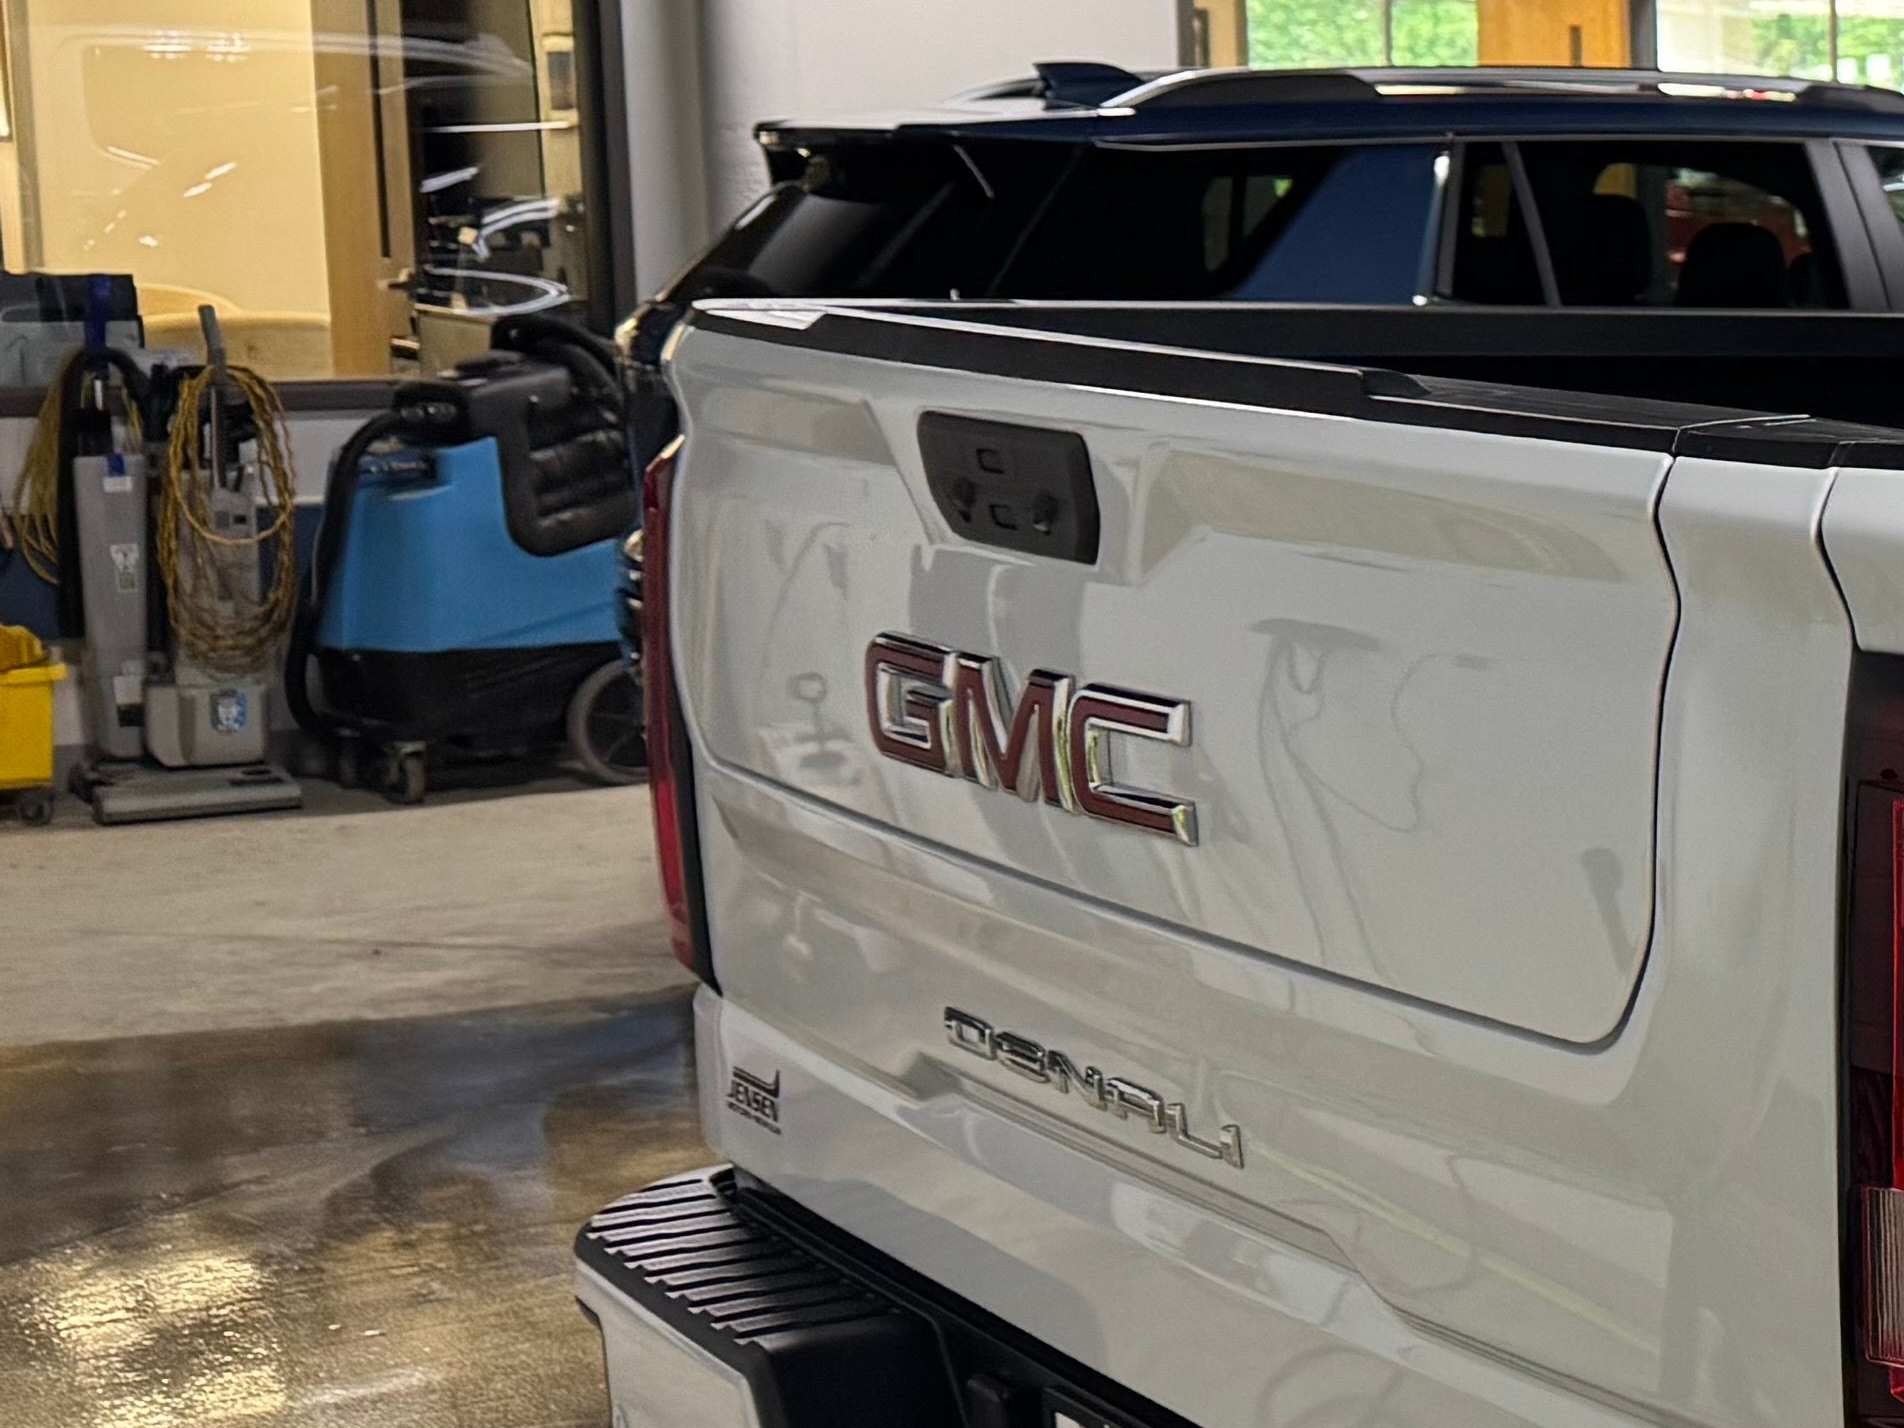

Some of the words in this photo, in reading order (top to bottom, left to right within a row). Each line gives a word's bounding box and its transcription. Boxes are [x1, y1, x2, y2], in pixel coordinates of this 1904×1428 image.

[865, 631, 1199, 847] GMC
[727, 1079, 778, 1123] JENSEN
[944, 1006, 1245, 1169] DENALI
